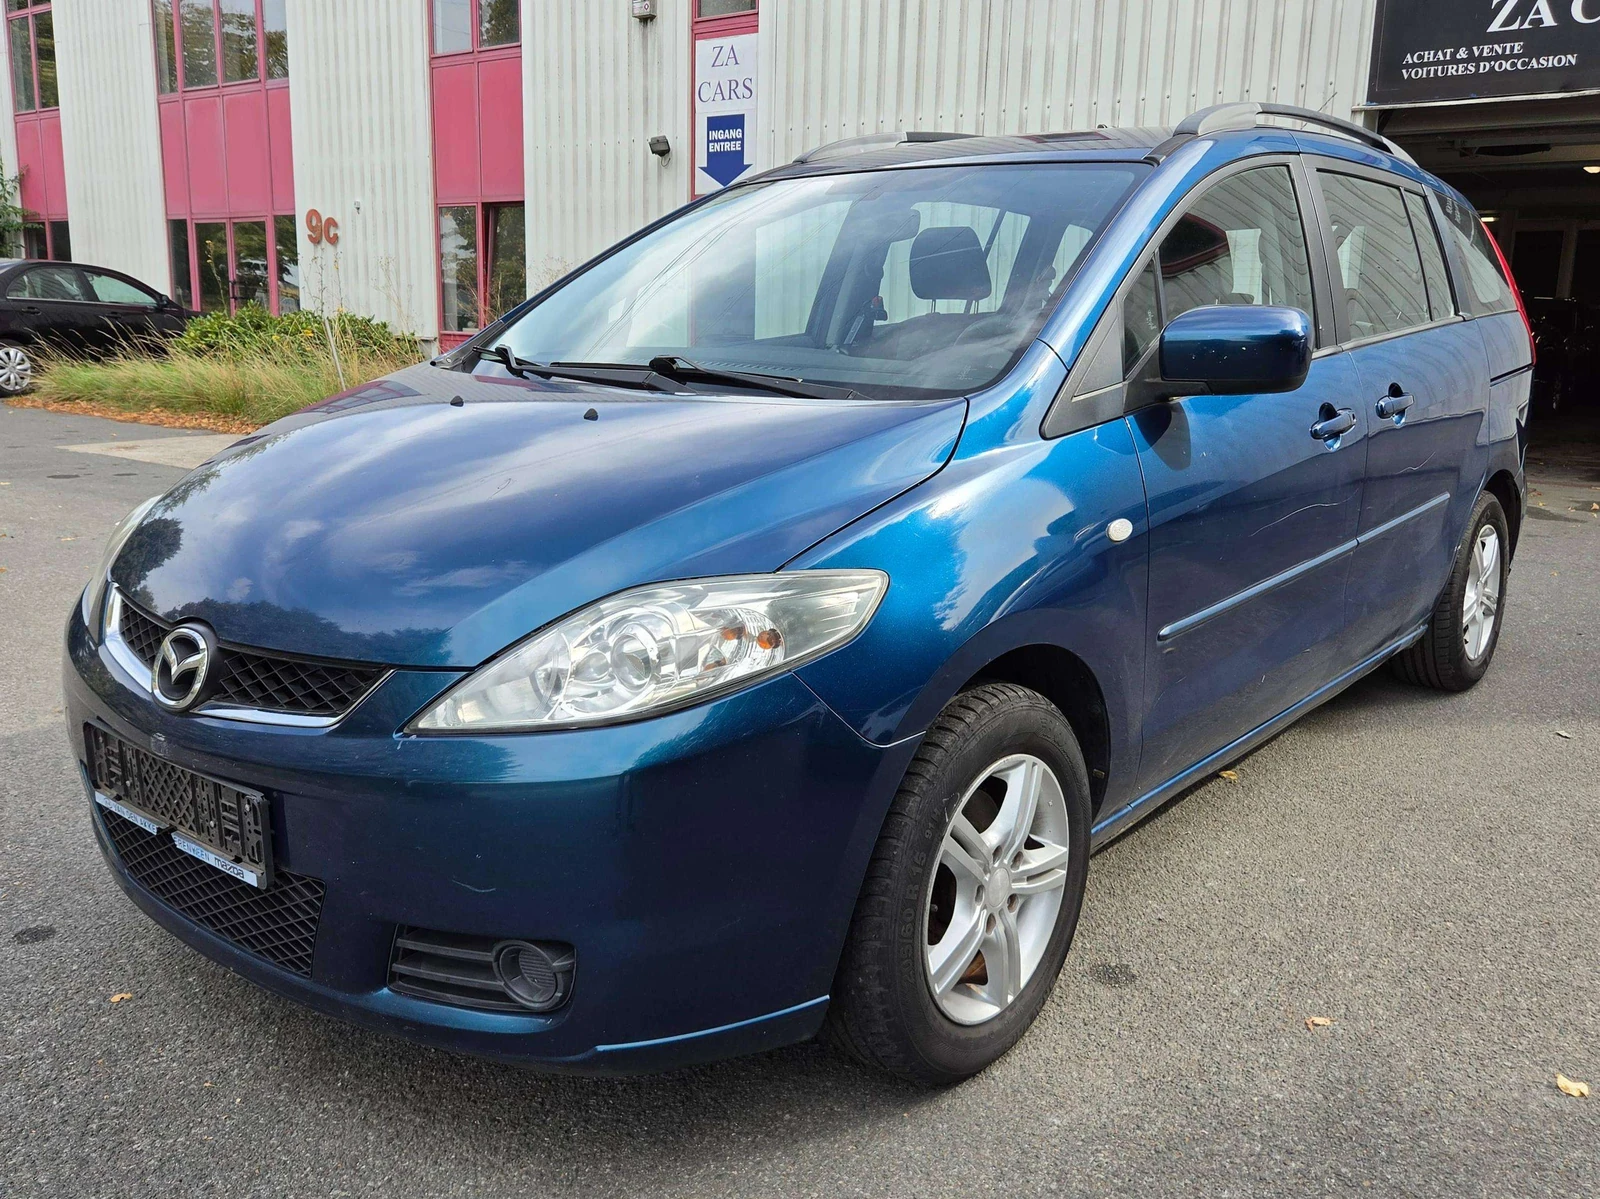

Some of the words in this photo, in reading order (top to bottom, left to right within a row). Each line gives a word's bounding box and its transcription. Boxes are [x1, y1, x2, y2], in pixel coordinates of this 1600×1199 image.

[1486, 0, 1558, 33] ZA
[711, 44, 740, 68] ZA
[1402, 48, 1454, 65] ACHAT
[1456, 47, 1469, 60] &
[1472, 41, 1524, 58] VENTE
[1401, 62, 1476, 80] VOITURES
[1478, 53, 1578, 75] D'OCCASION
[698, 77, 753, 103] CARS
[709, 128, 743, 141] INGANG
[709, 140, 742, 153] ENTREE
[305, 208, 339, 246] 9c
[214, 856, 245, 879] mazda
